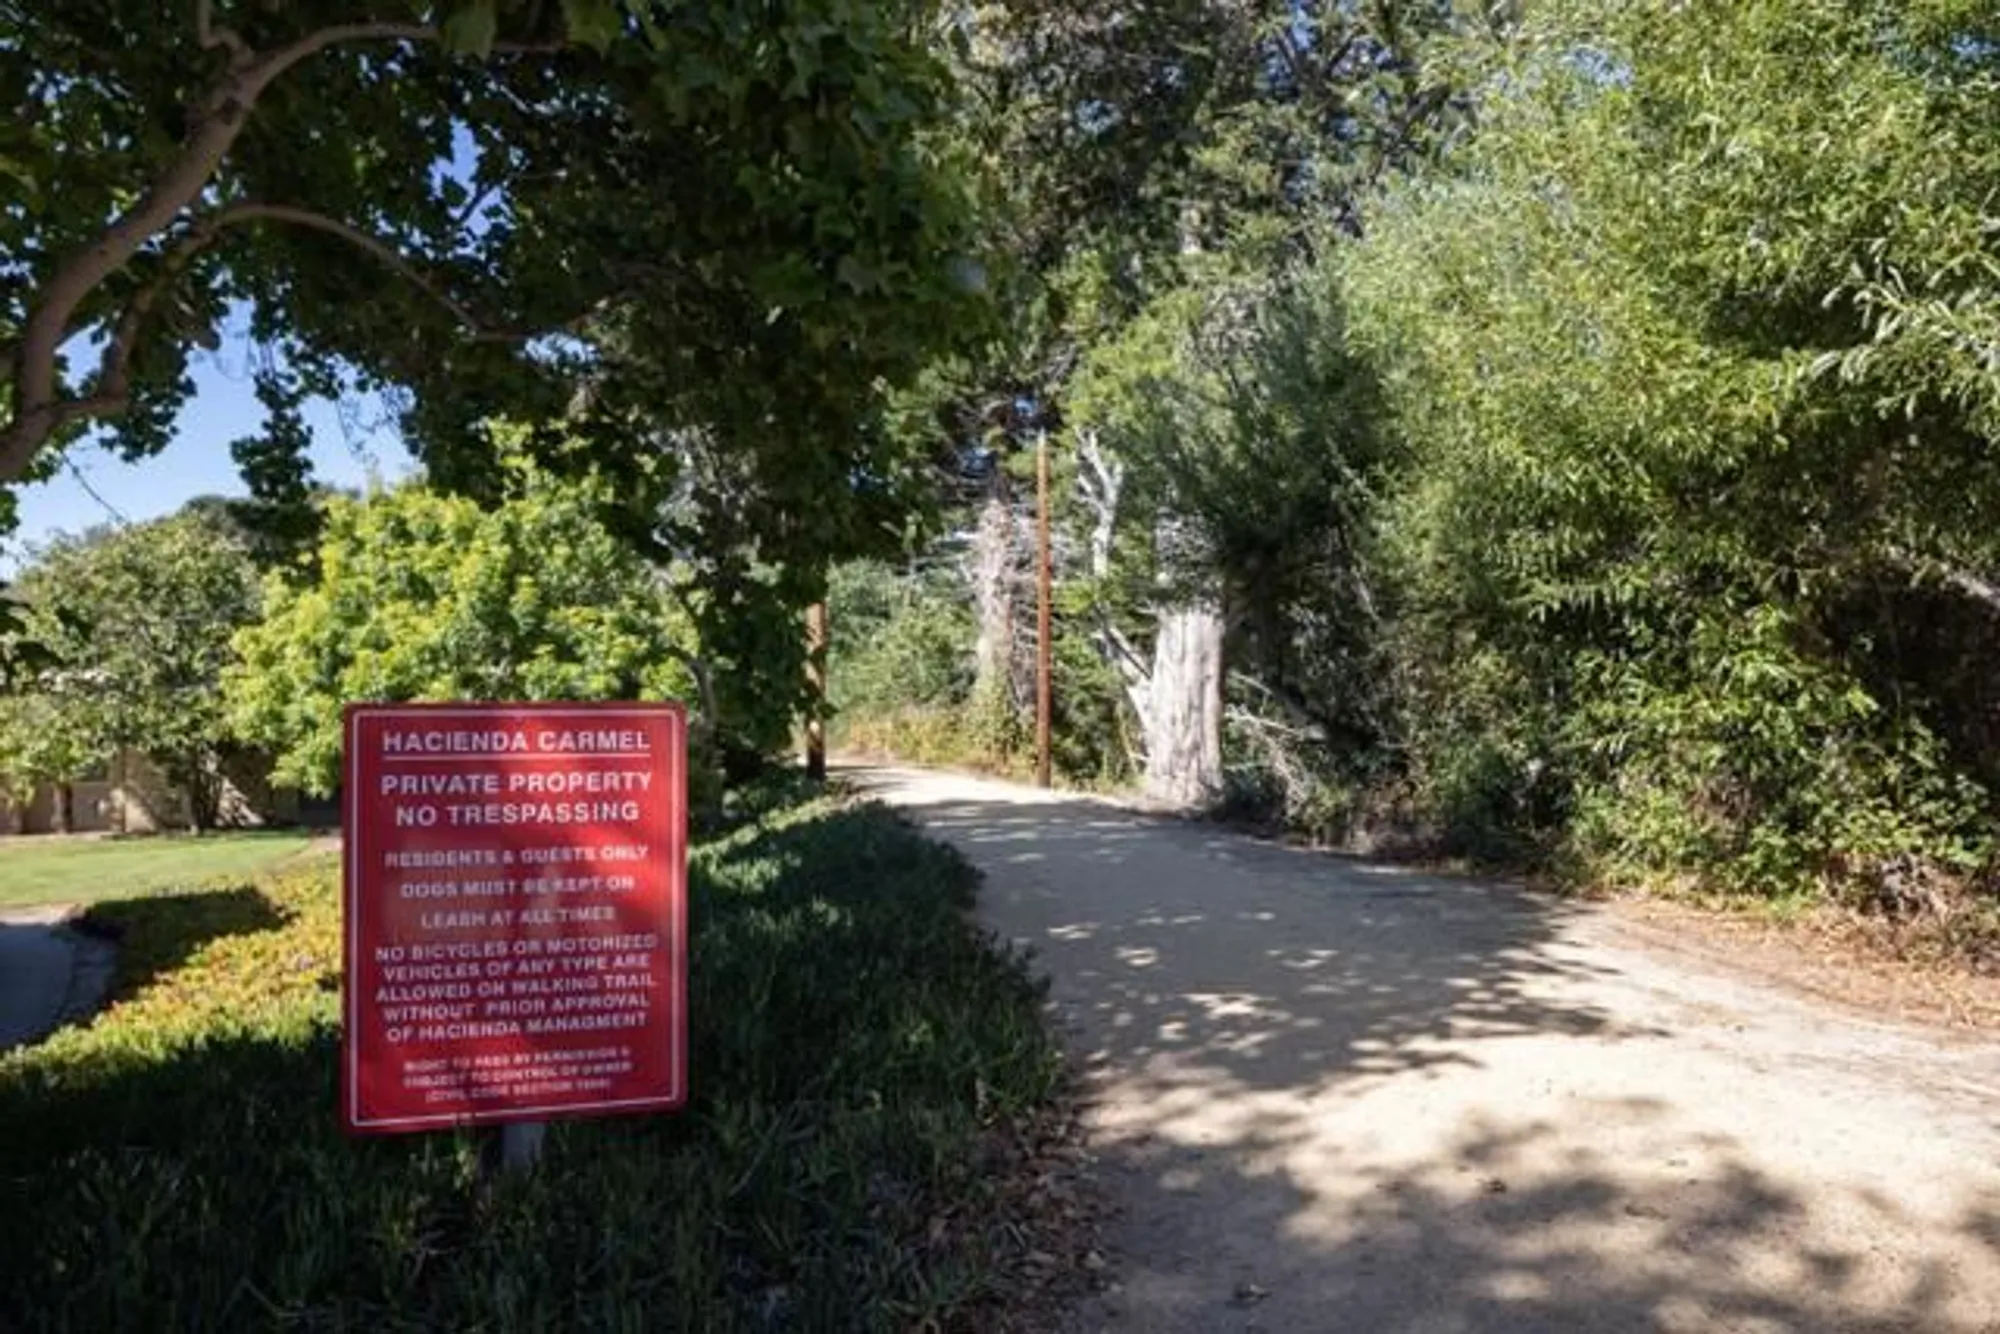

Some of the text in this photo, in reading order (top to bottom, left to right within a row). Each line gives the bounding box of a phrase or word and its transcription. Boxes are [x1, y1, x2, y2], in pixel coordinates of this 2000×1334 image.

[382, 730, 651, 752] HACIENDA CARMEL
[381, 771, 652, 795] PRIVATE PROPERTY
[396, 801, 640, 826] NO TRESPASSING
[385, 848, 497, 868] RESIDENTS
[521, 846, 596, 865] GUESTS
[600, 845, 649, 859] ONLY
[401, 881, 457, 898] DOGS
[463, 879, 515, 895] MUST
[552, 876, 600, 893] KEPT
[606, 875, 635, 891] ON
[421, 906, 616, 929] LEASH AT ALL TIMES
[375, 934, 658, 962] NO BICYCLES OR MOTORIZED
[384, 953, 650, 982] VEHICLES OF ANY TYPE ARE
[376, 973, 656, 1003] ALLOWED ON WALKING TRAIL
[384, 994, 651, 1022] WITHOUT PRIOR APPROVAL
[386, 1027, 413, 1043] OF
[419, 1021, 521, 1041] HACIENDA
